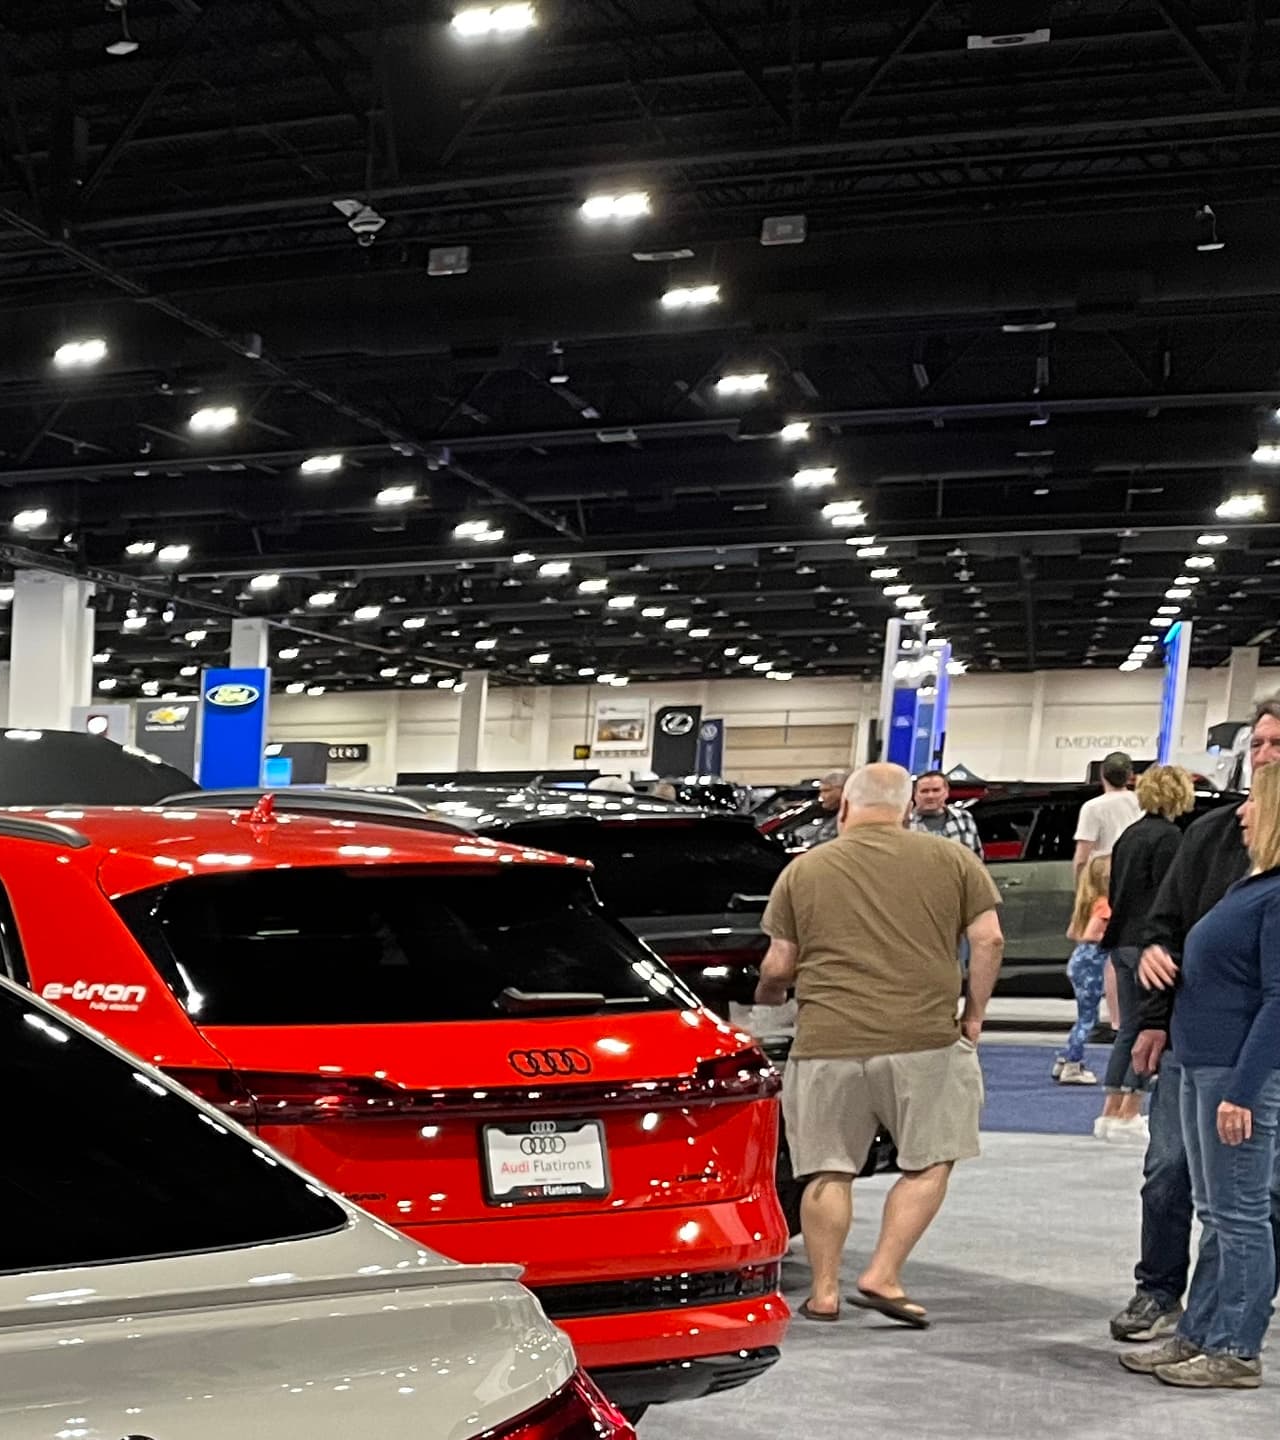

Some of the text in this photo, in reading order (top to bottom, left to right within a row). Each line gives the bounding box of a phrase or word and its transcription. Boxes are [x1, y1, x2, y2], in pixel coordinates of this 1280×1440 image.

[1055, 735, 1150, 750] EMERGENCY
[41, 979, 147, 1003] e-tron
[501, 1158, 592, 1175] Audi Flatirons
